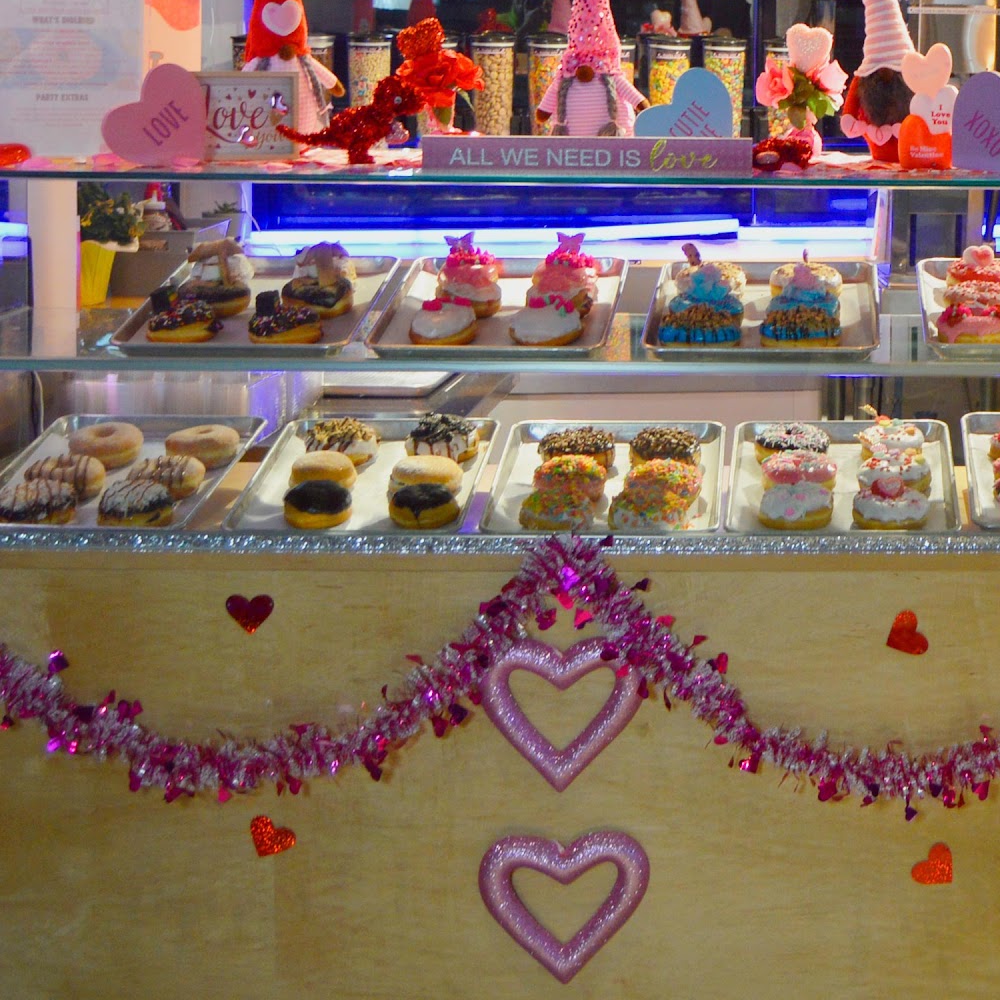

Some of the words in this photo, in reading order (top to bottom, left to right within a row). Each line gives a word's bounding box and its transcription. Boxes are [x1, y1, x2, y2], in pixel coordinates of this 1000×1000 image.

[142, 101, 189, 147] LOVE
[450, 149, 493, 167] ALL
[500, 149, 539, 167] WE
[546, 149, 611, 167] NEED
[619, 149, 641, 168] IS
[650, 138, 719, 172] love
